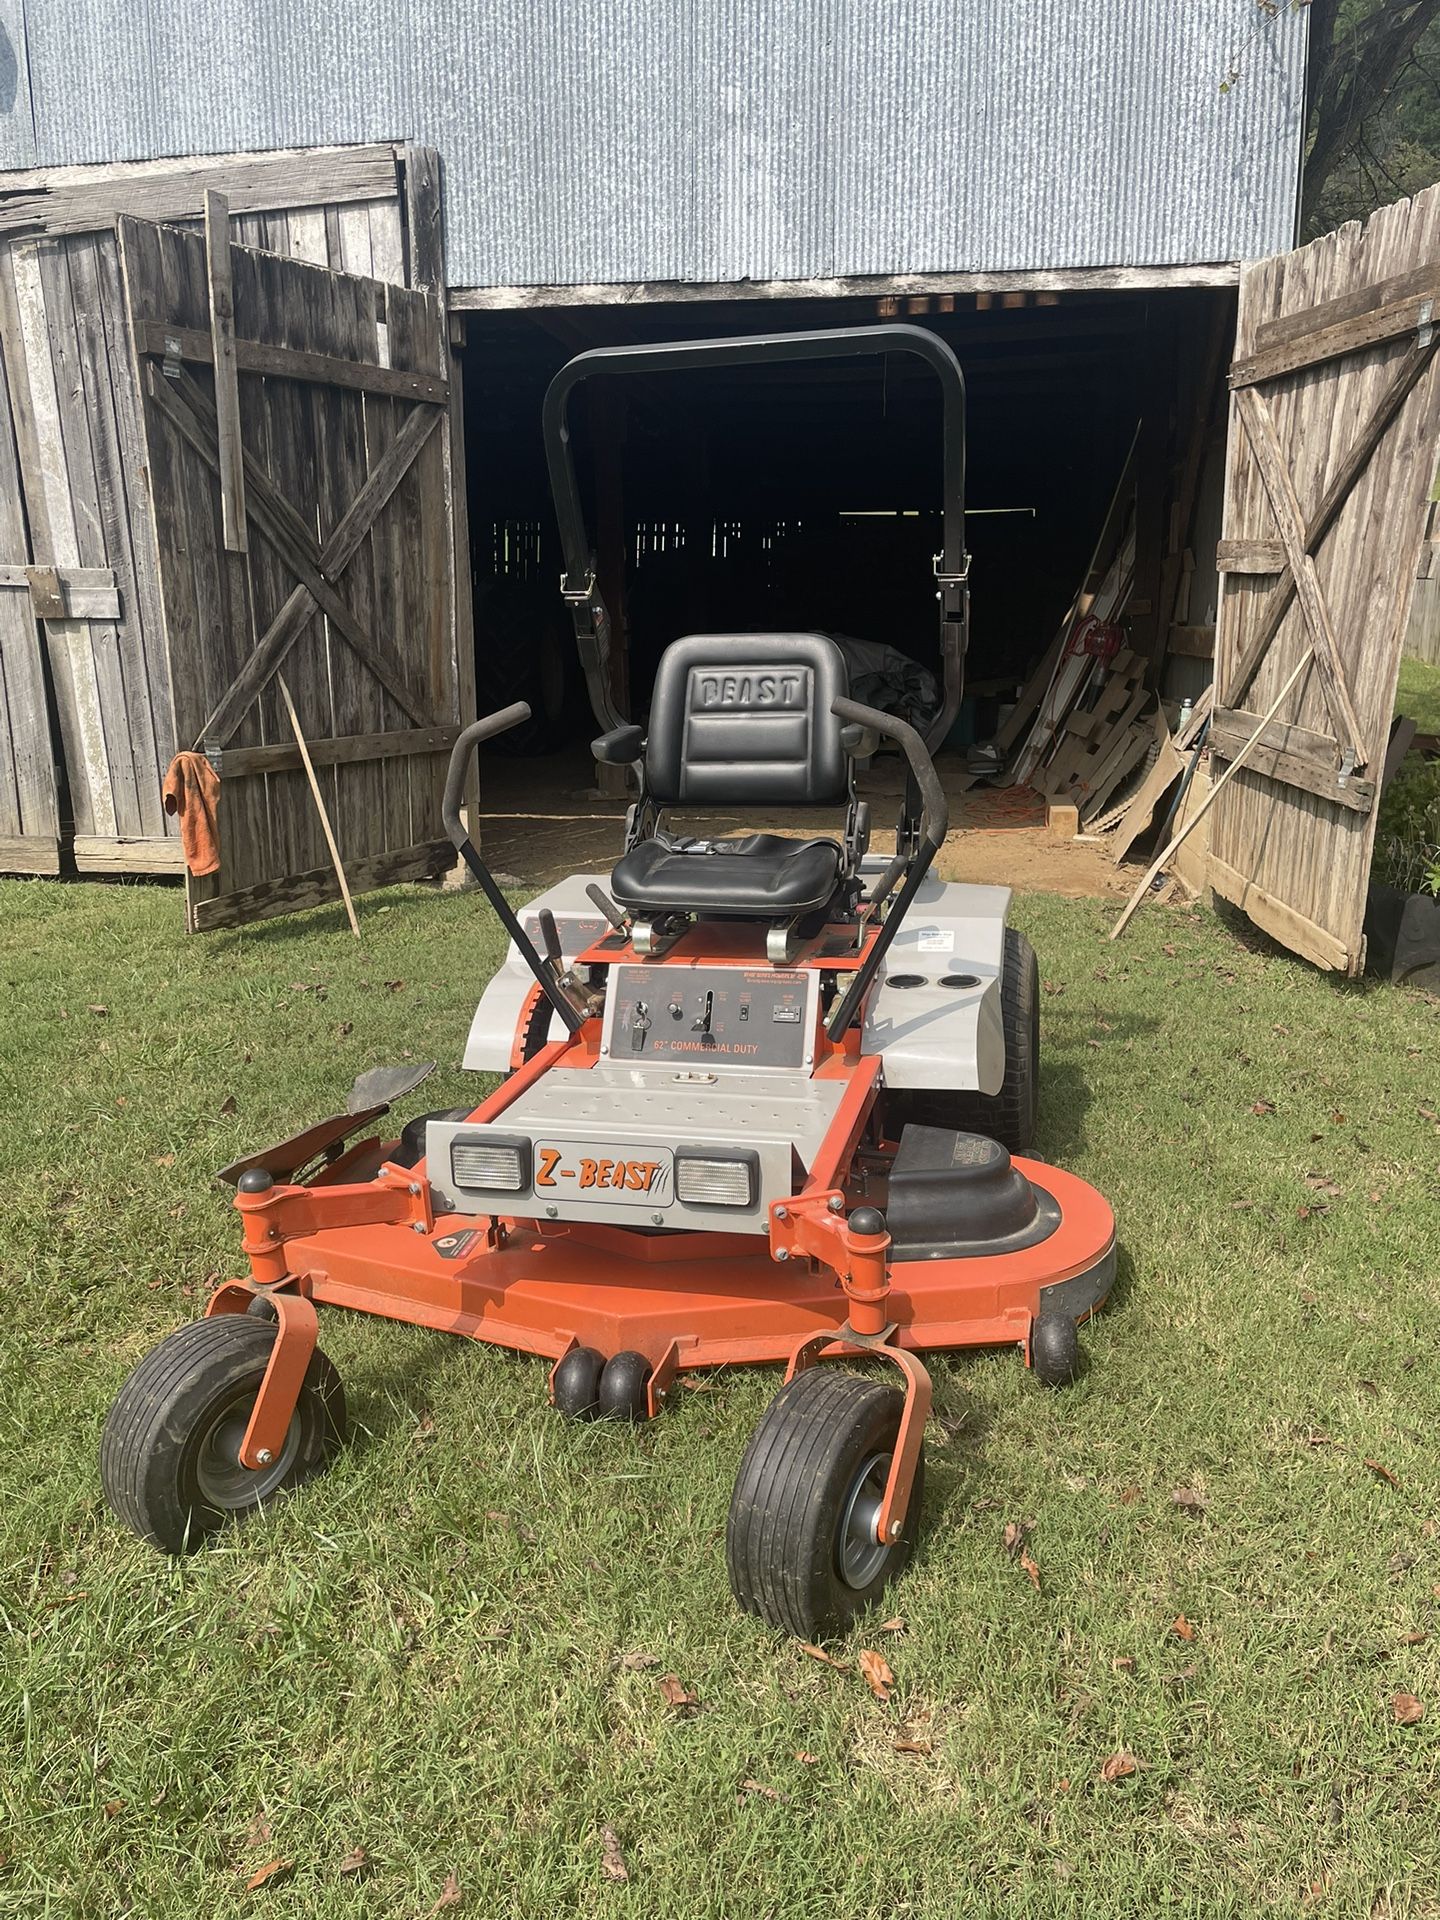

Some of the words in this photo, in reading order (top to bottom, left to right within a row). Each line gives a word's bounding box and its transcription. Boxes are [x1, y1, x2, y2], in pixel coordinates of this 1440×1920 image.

[701, 675, 800, 706] BEAST
[670, 1040, 732, 1053] COMMERCIAL
[733, 1043, 759, 1055] DUTY
